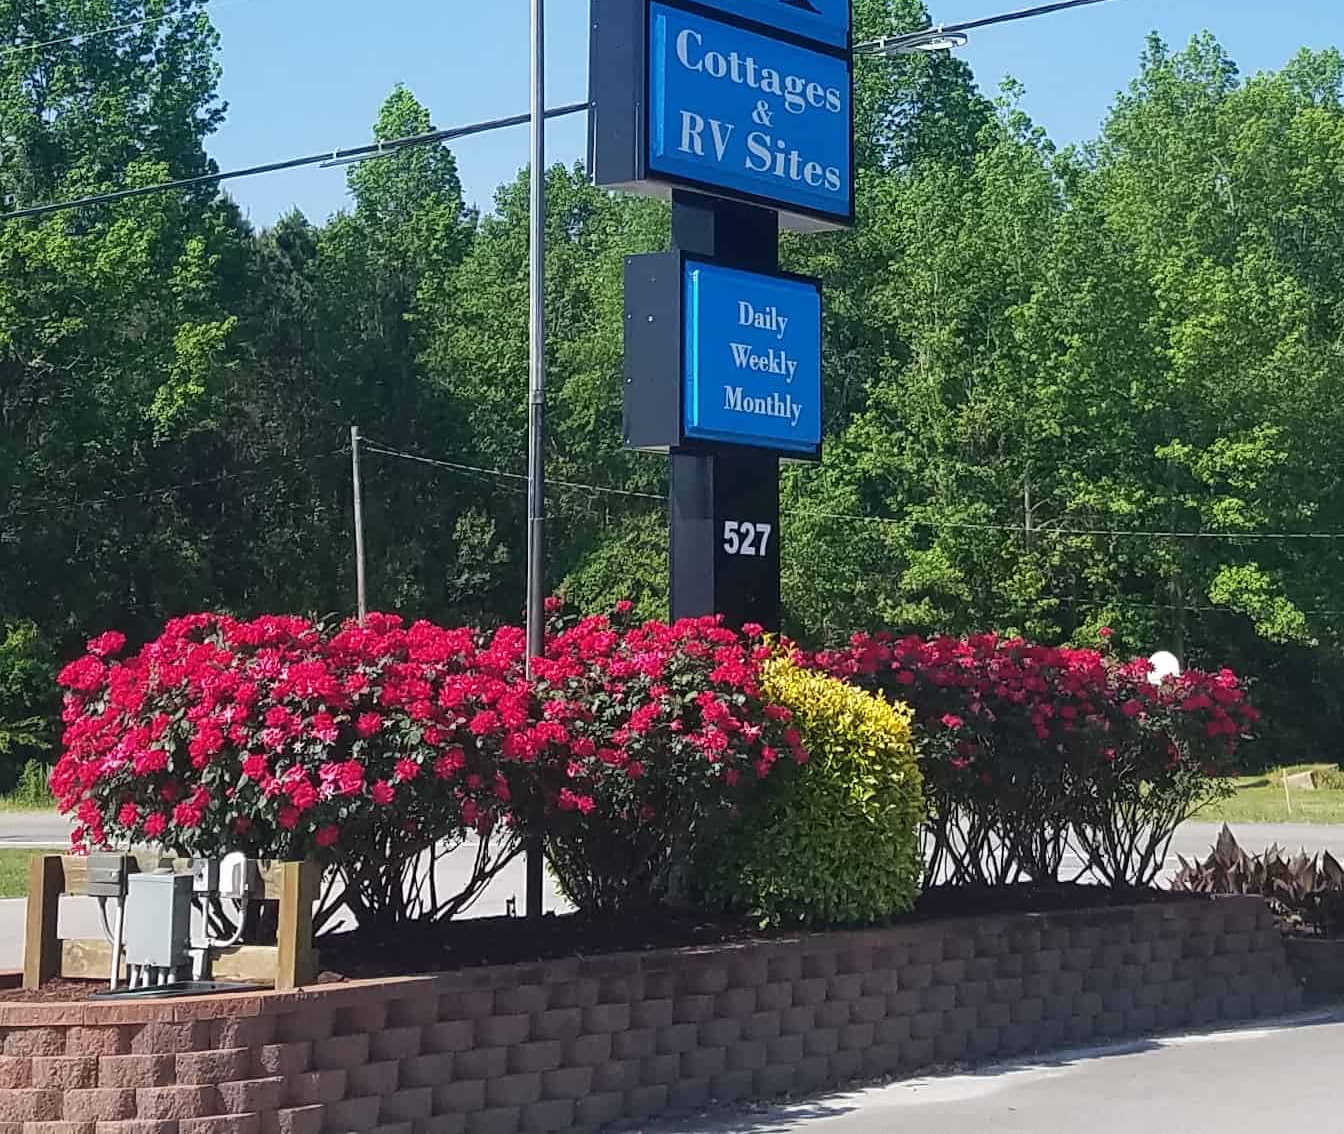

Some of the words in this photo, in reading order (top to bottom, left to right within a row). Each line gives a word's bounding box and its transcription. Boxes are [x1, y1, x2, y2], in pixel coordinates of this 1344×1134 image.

[676, 29, 841, 114] Cottages
[751, 99, 774, 127] &
[678, 111, 735, 163] RV
[745, 131, 840, 192] Sites
[738, 301, 789, 339] Daily
[730, 343, 797, 383] Weekly
[724, 386, 802, 425] Monthly
[723, 521, 771, 556] 527
